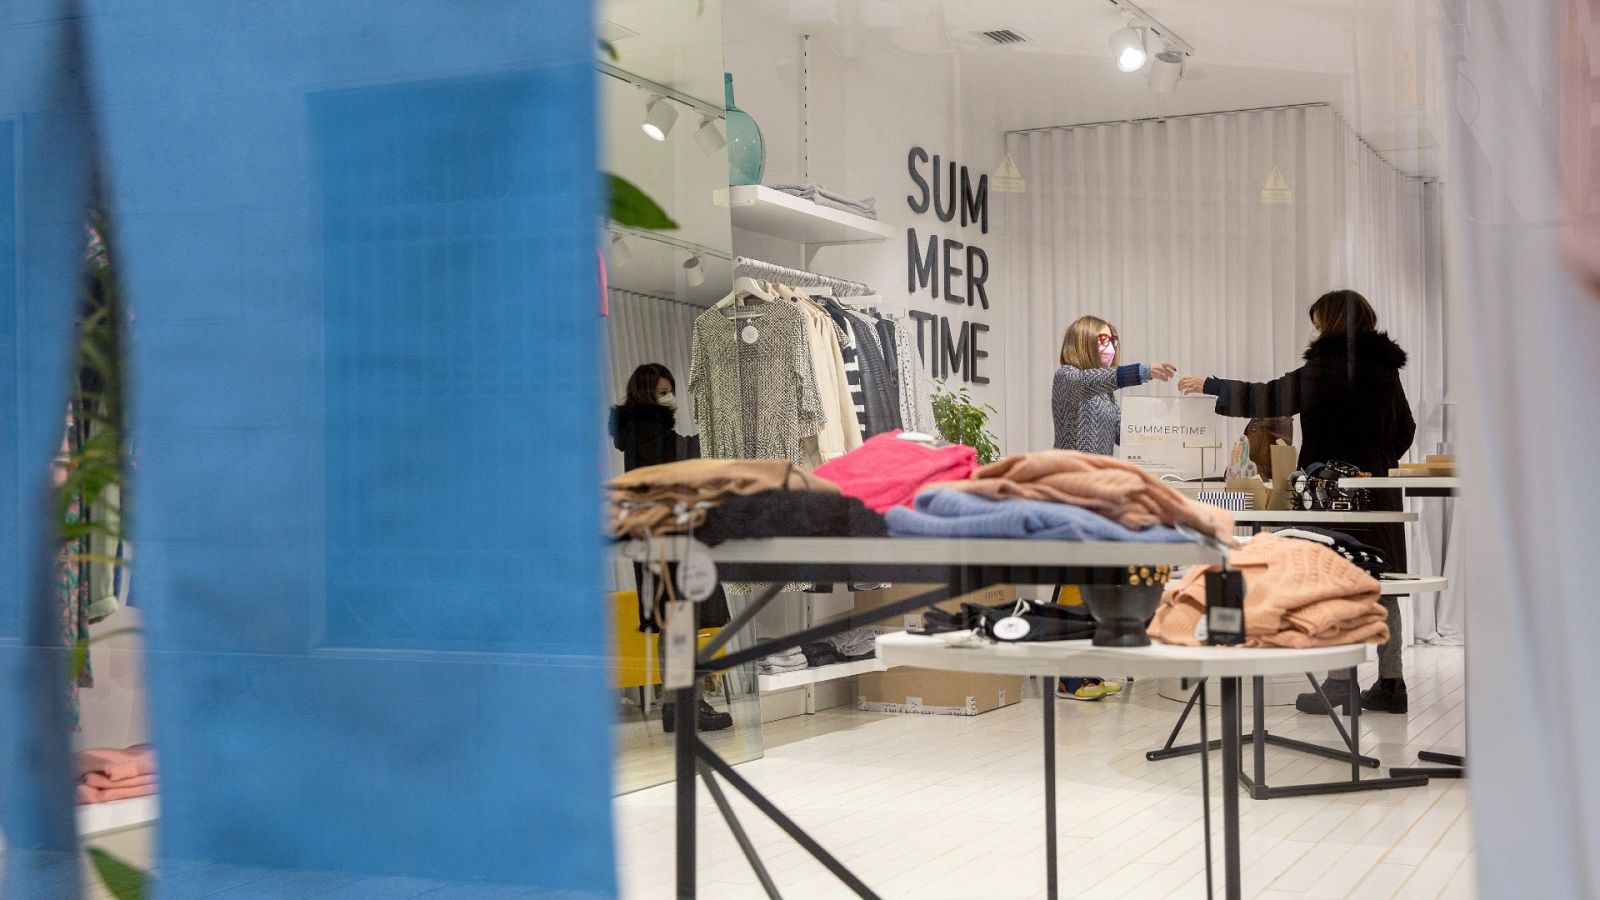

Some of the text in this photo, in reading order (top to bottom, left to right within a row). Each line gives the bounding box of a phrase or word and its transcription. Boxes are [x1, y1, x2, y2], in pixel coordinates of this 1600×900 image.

[907, 147, 988, 234] SUM
[907, 227, 989, 310] MER
[908, 309, 990, 384] TIME
[1127, 424, 1207, 435] SUMMERTIME
